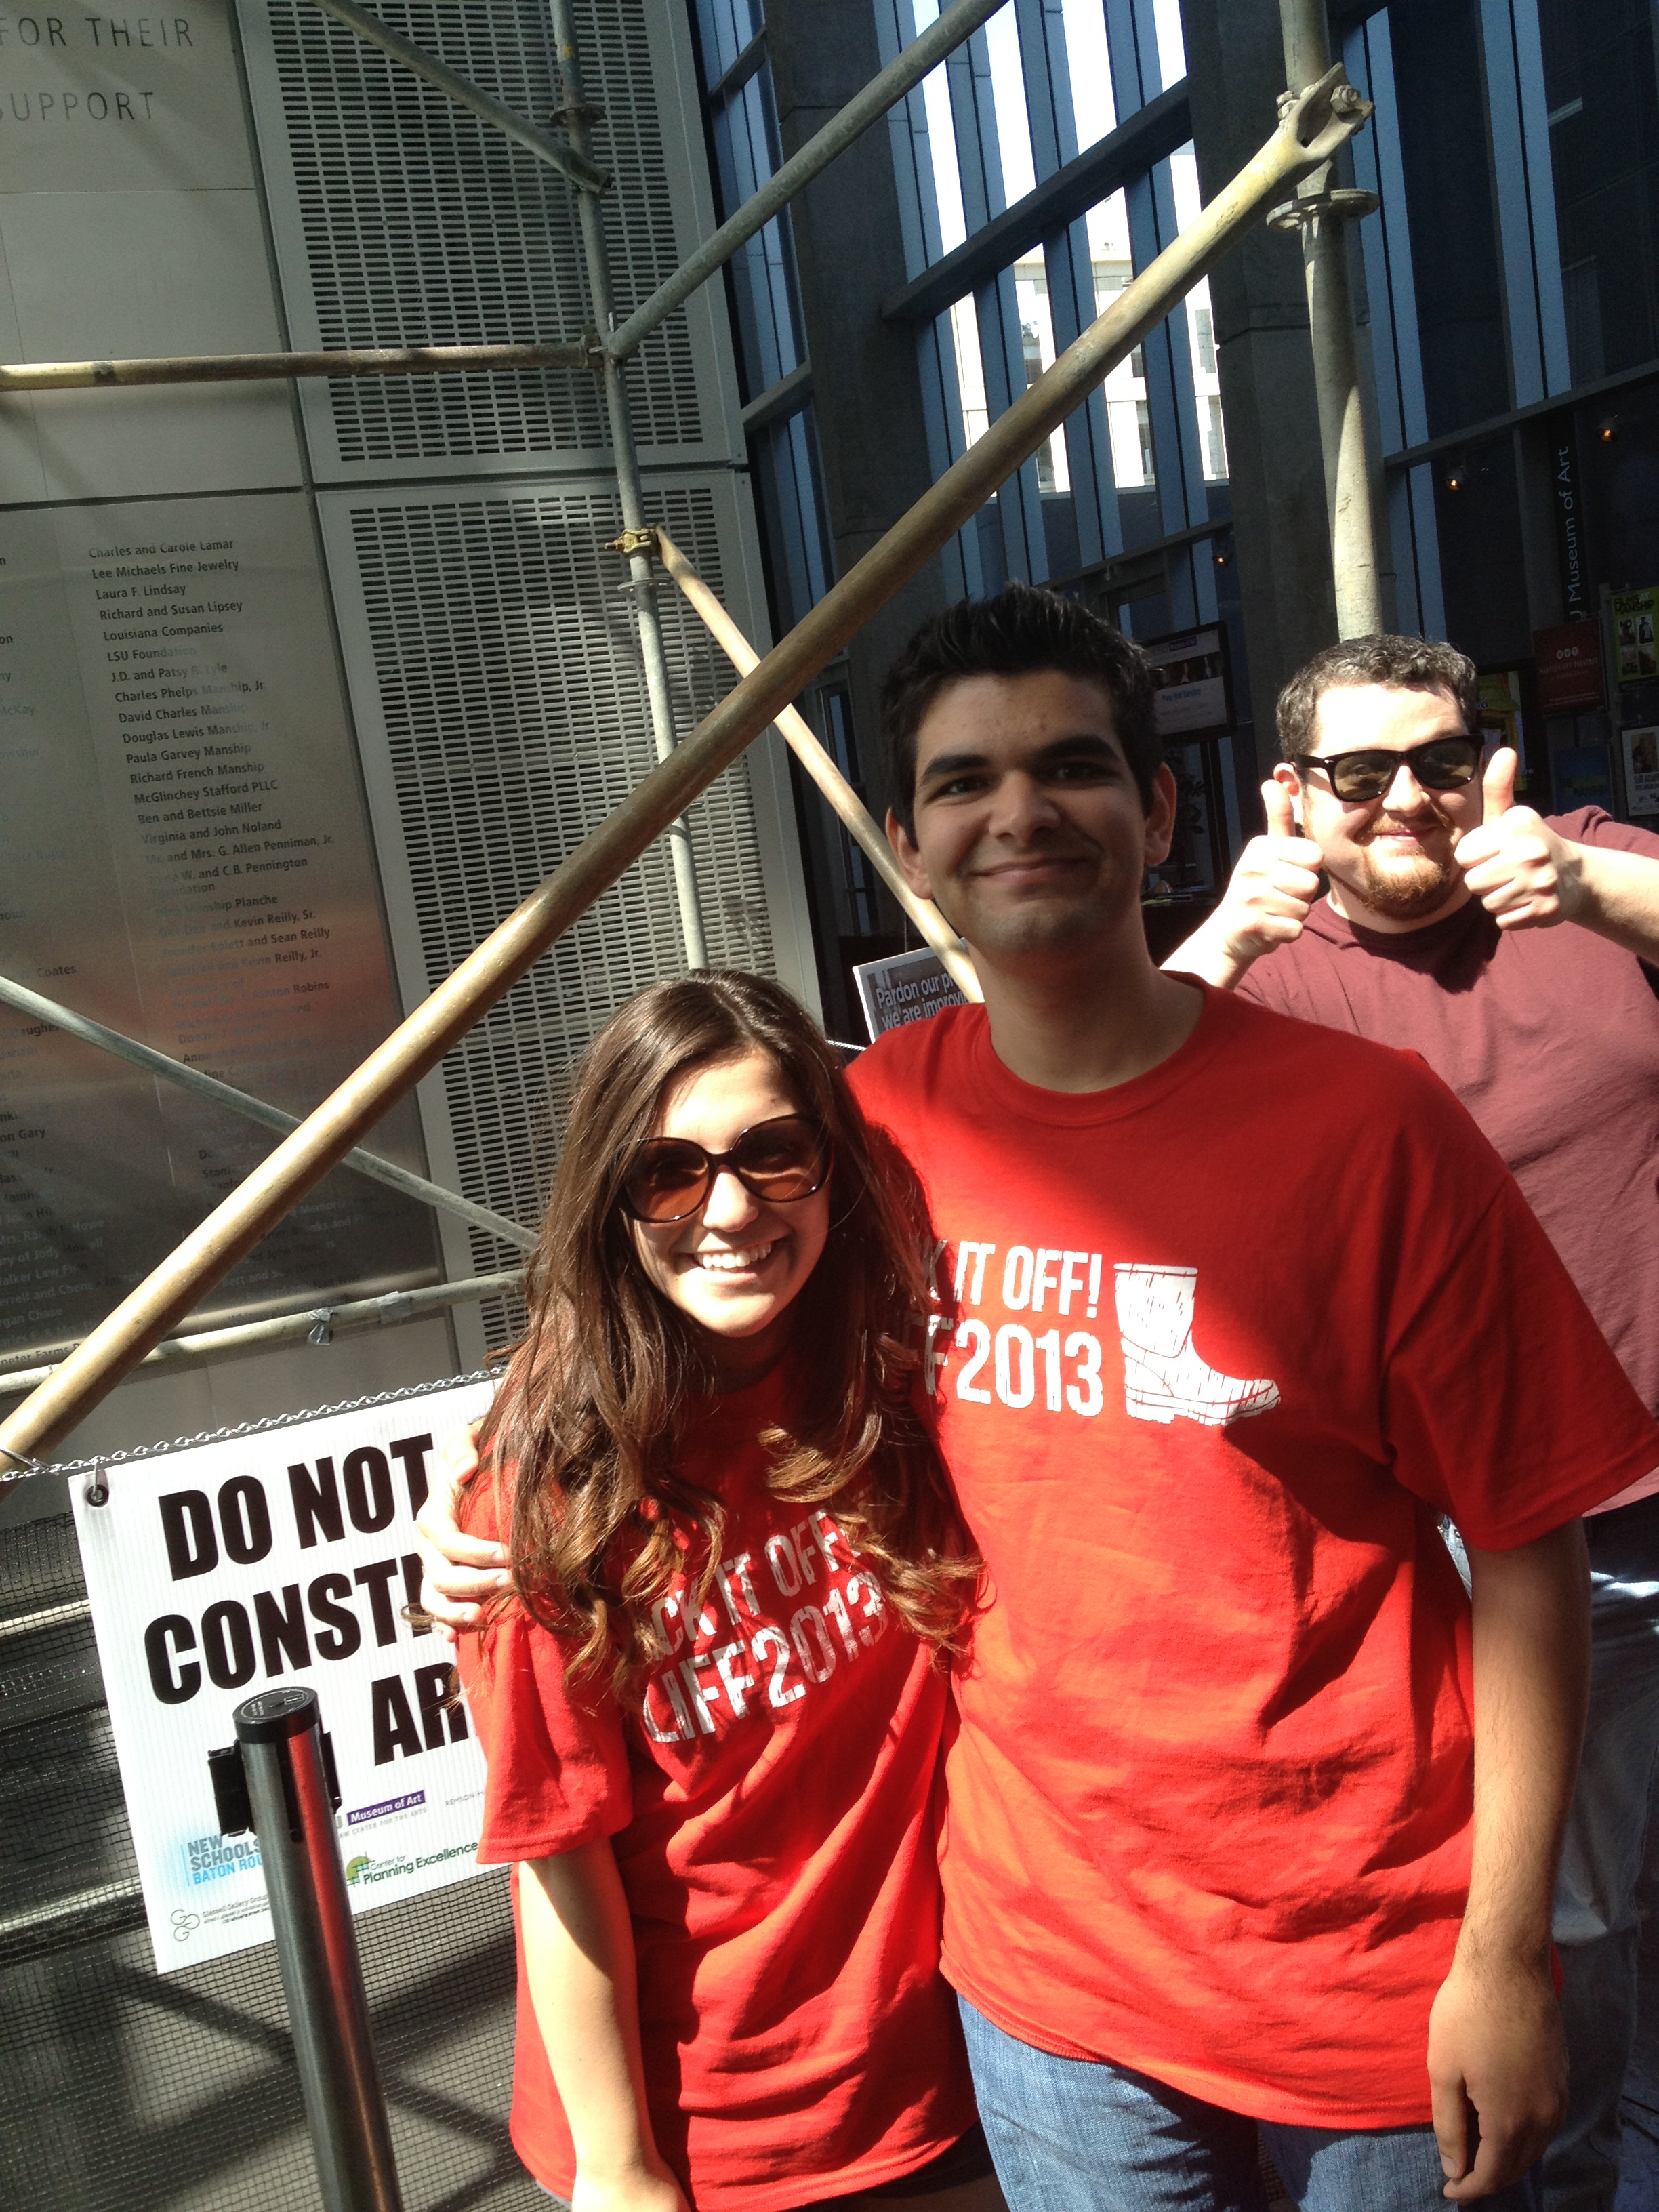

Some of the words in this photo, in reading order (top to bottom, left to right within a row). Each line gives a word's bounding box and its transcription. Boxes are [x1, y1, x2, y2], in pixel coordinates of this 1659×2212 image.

[85, 17, 193, 47] THEIR
[0, 91, 154, 121] UPPORT
[1557, 445, 1571, 483] Art
[1559, 491, 1574, 510] of
[89, 546, 131, 558] Charles
[136, 544, 156, 555] and
[160, 541, 196, 554] Carole
[200, 539, 234, 551] Lamar
[91, 567, 112, 580] Lee
[116, 563, 167, 577] Michaels
[170, 561, 193, 574] Fine
[197, 558, 239, 573] Jewelry
[1567, 517, 1582, 602] Museum
[96, 587, 128, 600] Laura
[143, 583, 186, 598] Lindsay
[100, 607, 143, 621] Richard
[146, 606, 167, 617] and
[171, 604, 204, 616] Susan
[207, 600, 243, 615] Lipsey
[103, 628, 158, 642] Louisiana
[161, 622, 224, 638] Companies
[107, 651, 129, 662] LSU
[132, 646, 197, 660] Foundation
[111, 671, 131, 683] J.D.
[134, 669, 155, 681] and
[158, 666, 188, 682] Patsy
[115, 690, 158, 703] Charles
[161, 686, 198, 701] Phelps
[118, 710, 152, 724] David
[155, 707, 197, 720] Charles
[122, 729, 169, 745] Douglas
[172, 726, 204, 739] Lewis
[126, 751, 157, 764] Paula
[161, 747, 201, 762] Garvey
[204, 742, 251, 758] Manship
[129, 770, 173, 785] Richard
[177, 766, 214, 779] French
[218, 760, 264, 777] Manship
[134, 787, 199, 804] McGlinchey
[203, 782, 249, 798] Stafford
[251, 779, 278, 792] PLLC
[138, 813, 160, 825] Ben
[163, 809, 184, 823] and
[187, 805, 226, 819] Bettsie
[230, 801, 263, 814] Miller
[141, 832, 186, 846] Virginia
[190, 827, 210, 840] and
[213, 823, 239, 838] John
[241, 819, 282, 833] Noland
[167, 850, 187, 863] and
[190, 847, 216, 860] Mrs.
[218, 845, 229, 857] G.
[232, 841, 261, 855] Allen
[264, 836, 321, 852] Penniman,
[199, 866, 220, 880] and
[245, 857, 308, 874] Pennington
[234, 894, 278, 909] Planche
[211, 920, 230, 932] and
[234, 916, 264, 930] Kevin
[267, 912, 300, 926] Reilly,
[247, 934, 268, 947] and
[270, 931, 297, 945] Sean
[300, 926, 330, 941] Reilly
[241, 955, 272, 968] Kevin
[274, 949, 308, 964] Reilly,
[37, 965, 77, 978] Coates
[293, 981, 330, 995] Robins
[876, 981, 920, 1009] Pardon
[920, 975, 940, 996] our
[882, 1011, 901, 1031] we
[902, 1004, 922, 1023] are
[18, 1128, 45, 1140] Gary
[34, 1246, 59, 1260] Jody
[35, 1268, 58, 1279] Law
[953, 1240, 996, 1305] IT
[1002, 1245, 1103, 1319] OFF!
[33, 1287, 56, 1300] and
[28, 1307, 62, 1321] Chase
[36, 1347, 69, 1359] Farms
[158, 1474, 273, 1582] DO
[287, 1433, 434, 1550] NOT
[716, 1553, 761, 1626] IT
[350, 1804, 393, 1824] Museum
[394, 1798, 406, 1809] of
[407, 1794, 423, 1806] Art
[352, 1822, 377, 1835] CENTER
[380, 1818, 393, 1827] FOR
[410, 1807, 428, 1818] ARTS
[187, 1832, 223, 1857] NEW
[363, 1862, 414, 1885] Planning
[415, 1841, 478, 1868] Excellence
[369, 1856, 395, 1871] Center
[396, 1853, 407, 1863] for
[192, 1862, 236, 1885] BATON
